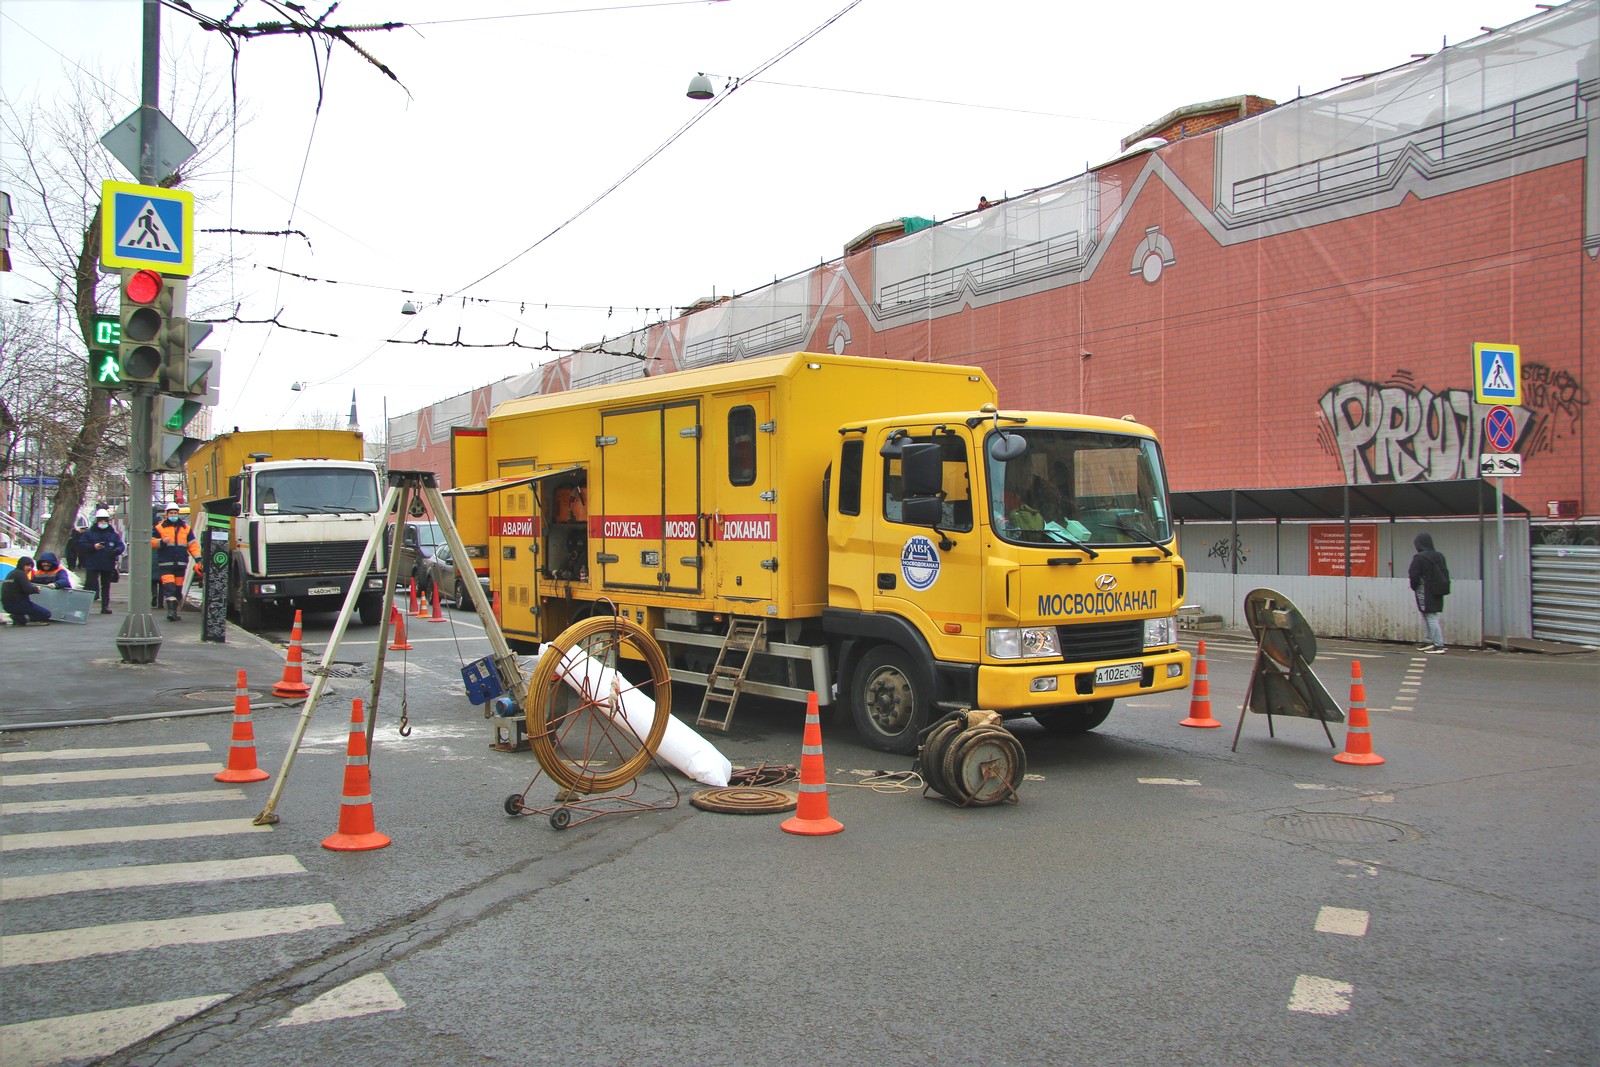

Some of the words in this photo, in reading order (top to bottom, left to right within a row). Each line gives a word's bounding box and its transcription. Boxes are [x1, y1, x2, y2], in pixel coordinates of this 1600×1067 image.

[502, 518, 533, 536] АВАРИЙ
[604, 521, 644, 538] СЛУЖБА
[665, 521, 696, 539] МОСВО
[723, 521, 771, 541] ДОКАНАЛ
[909, 543, 930, 553] МВК
[1038, 590, 1157, 616] МОСВОДОКАНАЛ
